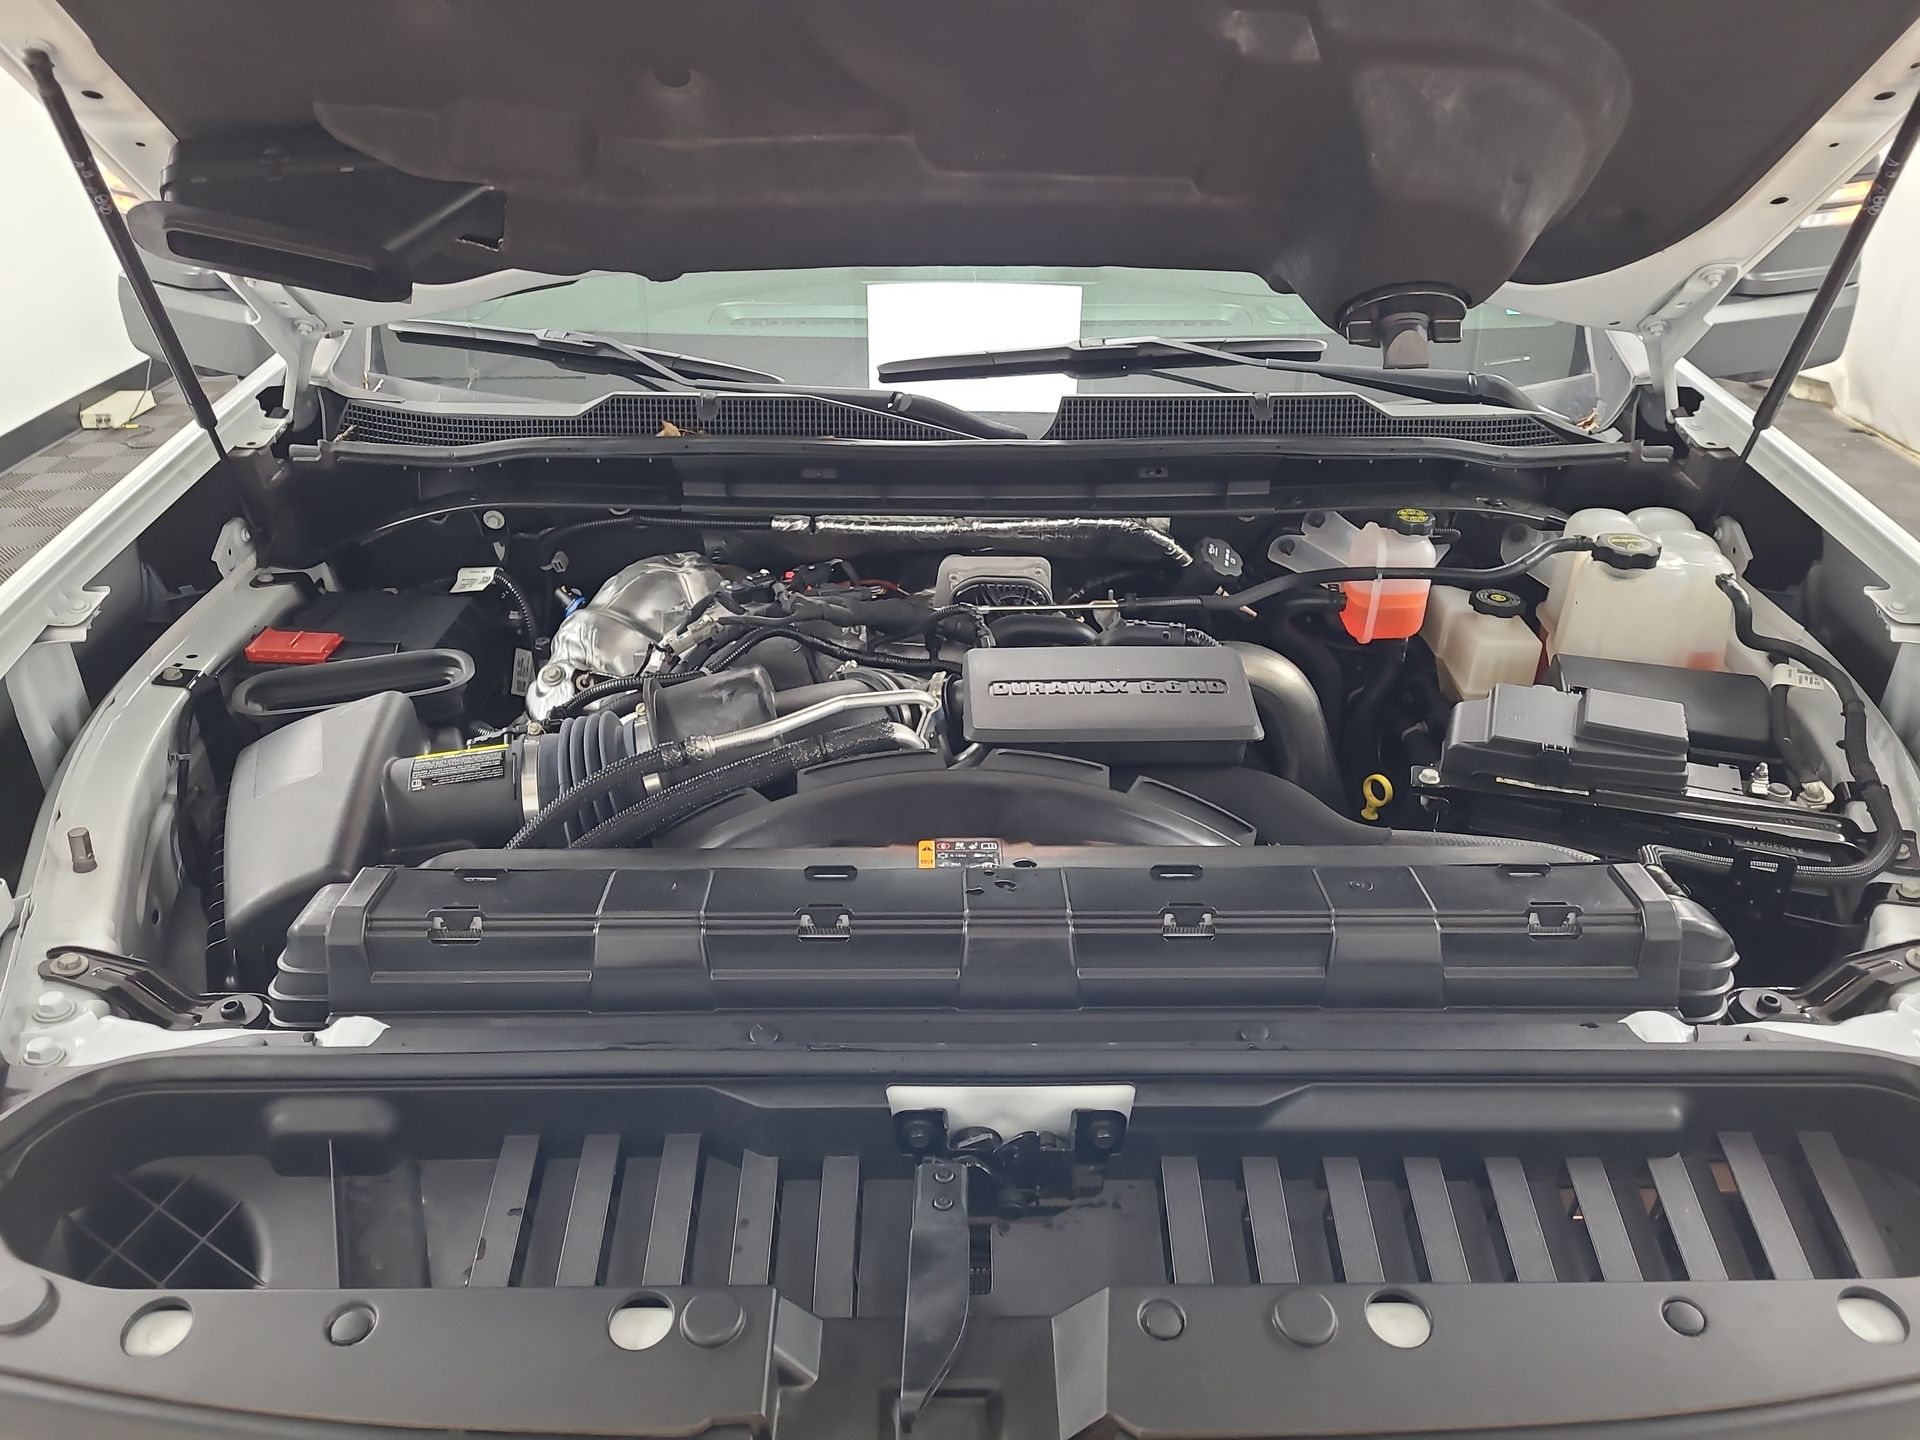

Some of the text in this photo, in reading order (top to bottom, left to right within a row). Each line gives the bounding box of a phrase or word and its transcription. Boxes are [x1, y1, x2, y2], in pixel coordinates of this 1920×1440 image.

[992, 680, 1226, 695] DURAMAX 6.6 HD
